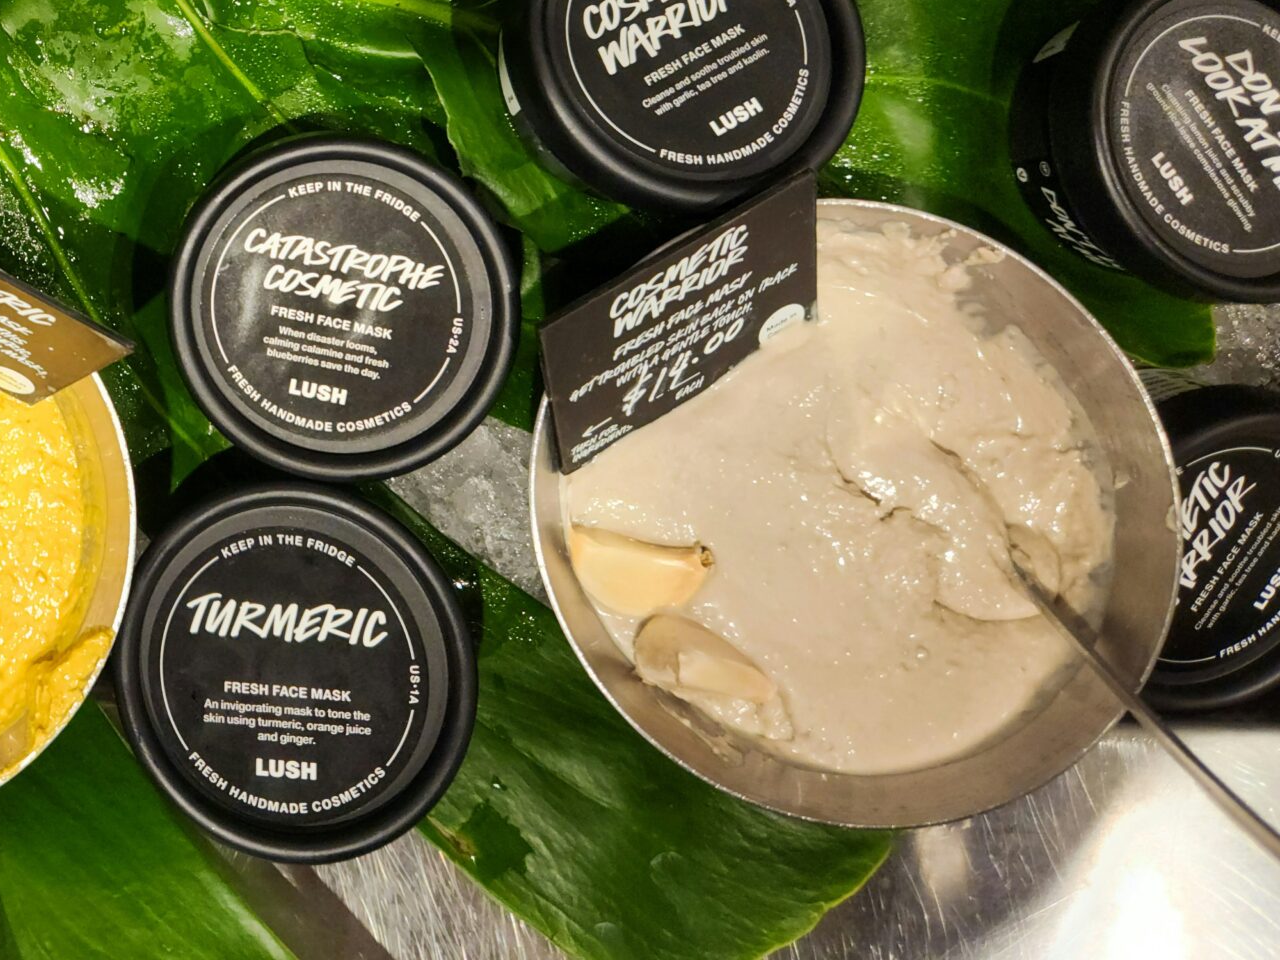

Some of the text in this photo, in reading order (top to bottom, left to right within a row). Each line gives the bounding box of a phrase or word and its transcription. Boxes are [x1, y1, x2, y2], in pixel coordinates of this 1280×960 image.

[644, 24, 746, 86] FRESH FACE MASK
[655, 47, 770, 116] with garlic, tea tree and kaolin.
[659, 68, 809, 165] FRESH HANDMADE COSMETICS
[709, 97, 763, 136] LUSH
[1184, 89, 1259, 193] FRESH FACE MASK
[288, 181, 421, 223] KEEP IN THE FRIDGE
[1121, 100, 1231, 254] FRESH HANDMADE COSMETICS
[1151, 151, 1194, 206] LUSH
[244, 228, 445, 289] CATASTROPHE
[610, 224, 748, 319] COSMETIC
[264, 265, 403, 312] COSMETIC
[614, 246, 748, 338] WARRIOR
[271, 305, 393, 339] FRESH FACE MASK
[263, 335, 389, 369] calming calamine and fresh
[266, 348, 381, 380] blueberries save the day.
[227, 364, 412, 432] FRESH HANDMADE COSMETICS
[288, 378, 348, 405] LUSH
[221, 533, 356, 567] KEEP IN THE FRIDGE
[1190, 511, 1264, 612] FRESH FACE MASK
[186, 592, 388, 647] TURMERIC
[224, 681, 351, 702] FRESH FACE MASK
[203, 712, 371, 736] skin using turmeric, orange juice
[257, 731, 316, 746] and ginger.
[188, 751, 386, 814] FRESH HANDMADE COSMETICS
[255, 758, 318, 781] LUSH
